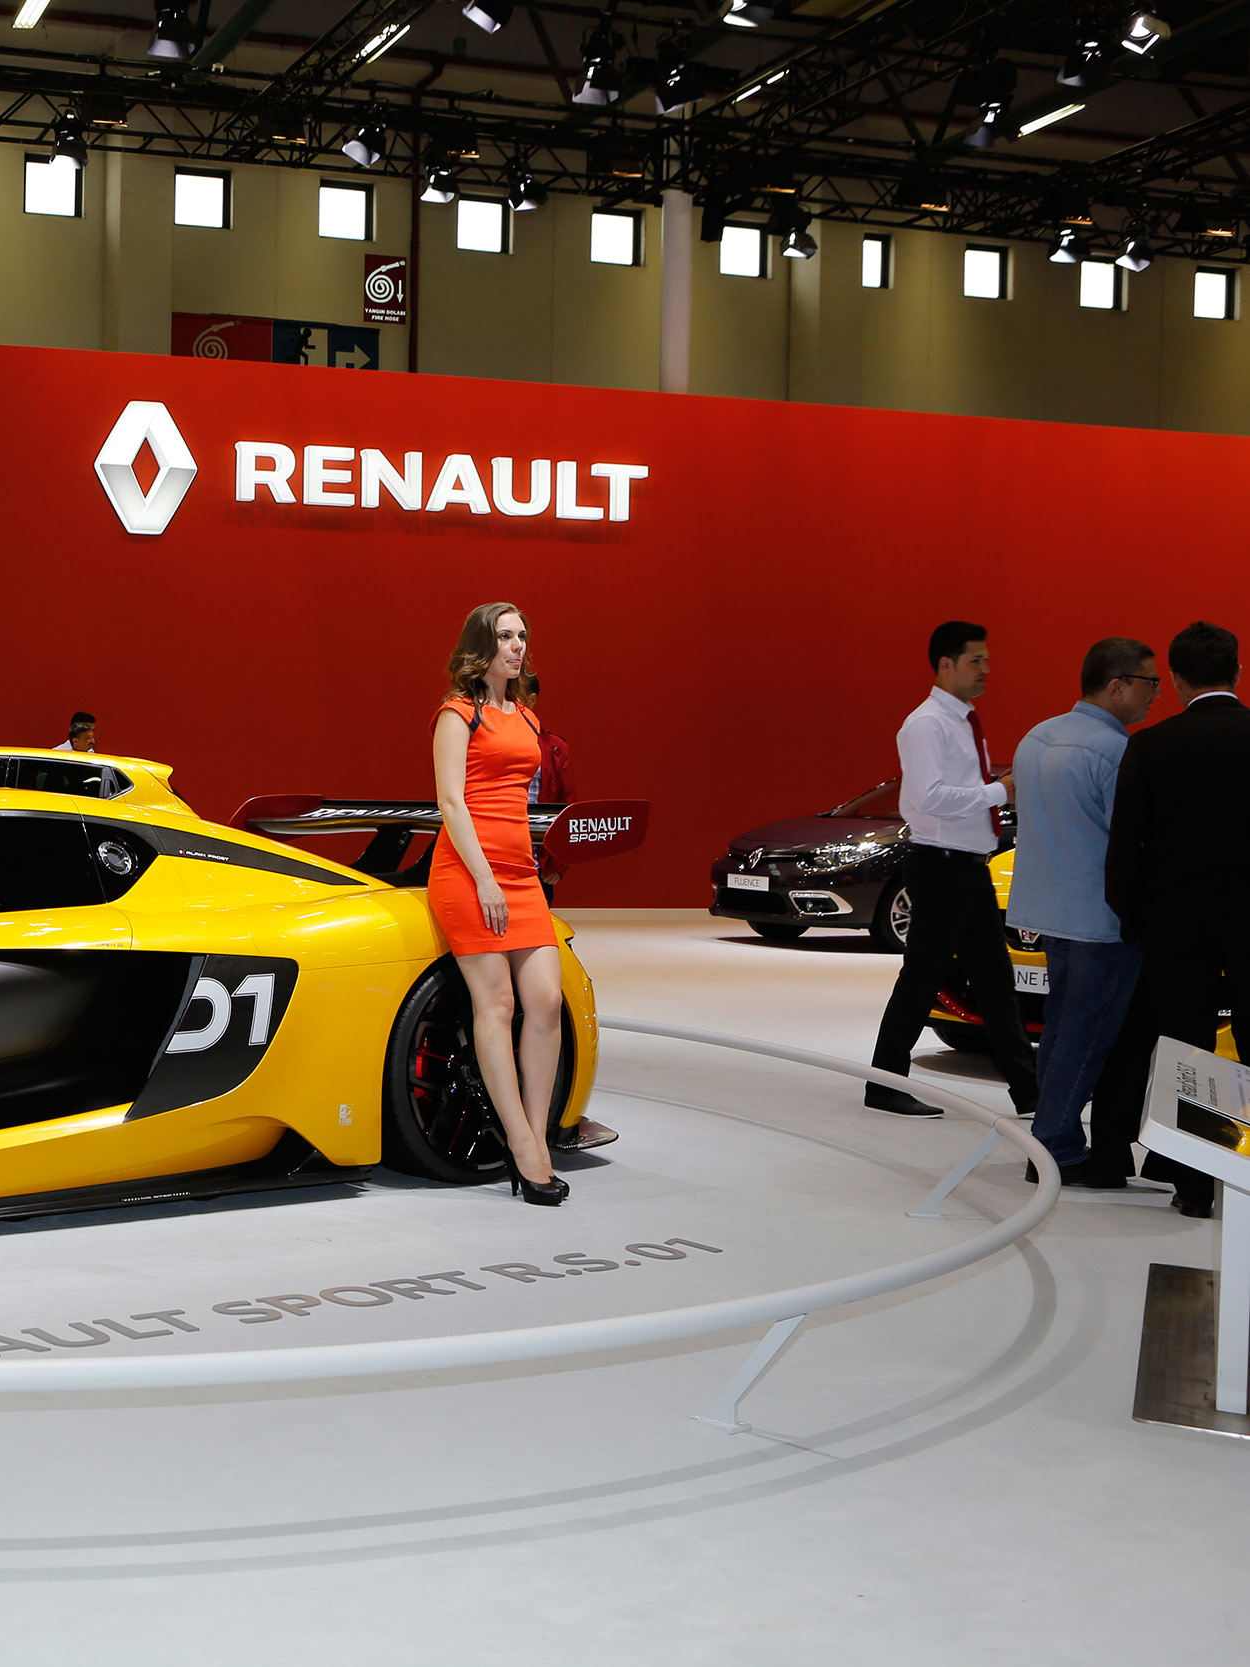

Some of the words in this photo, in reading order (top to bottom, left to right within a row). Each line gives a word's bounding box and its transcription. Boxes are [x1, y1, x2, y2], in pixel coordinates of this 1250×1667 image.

[235, 440, 649, 522] RENAULT
[569, 817, 632, 833] RENAULT
[569, 832, 617, 843] SPORT
[734, 877, 760, 887] FLUENCE
[1017, 970, 1038, 985] NE
[212, 1270, 486, 1324] SPORT
[479, 1237, 723, 1284] R.S.01
